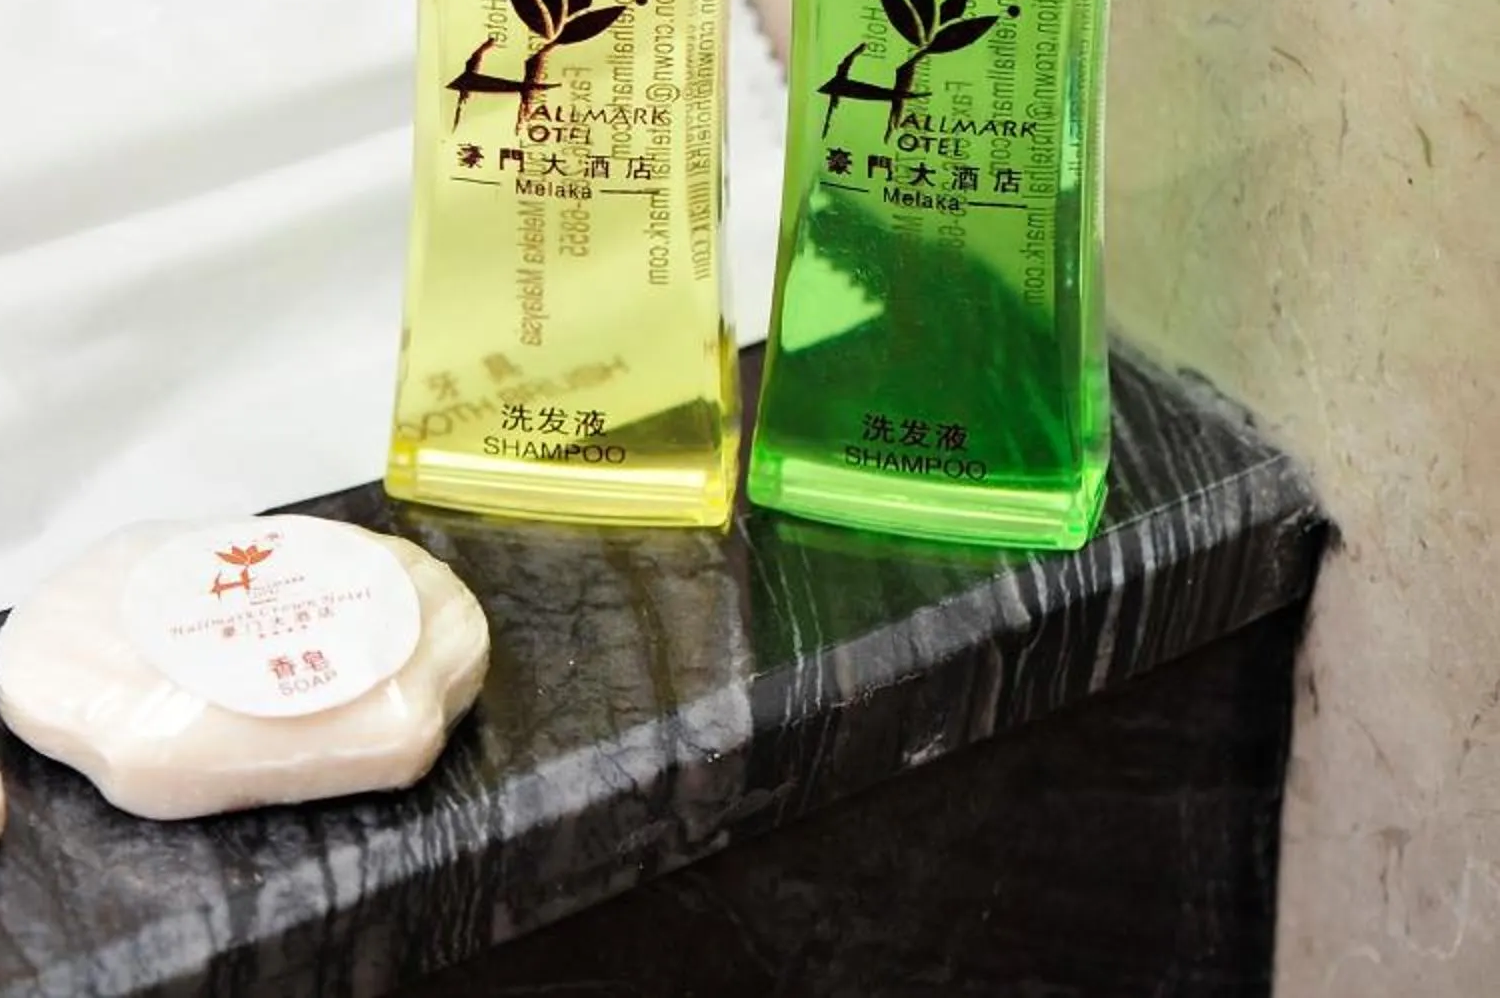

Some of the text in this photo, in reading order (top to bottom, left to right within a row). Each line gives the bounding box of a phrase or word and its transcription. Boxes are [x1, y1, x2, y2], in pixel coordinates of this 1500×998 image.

[516, 179, 592, 200] Melaka
[883, 187, 961, 210] Melaka
[501, 404, 607, 438] 洗发液
[862, 412, 970, 452] 洗发液
[483, 436, 626, 465] SHAMPOO
[843, 445, 987, 481] SHAMPOO
[278, 671, 338, 696] SOAP
